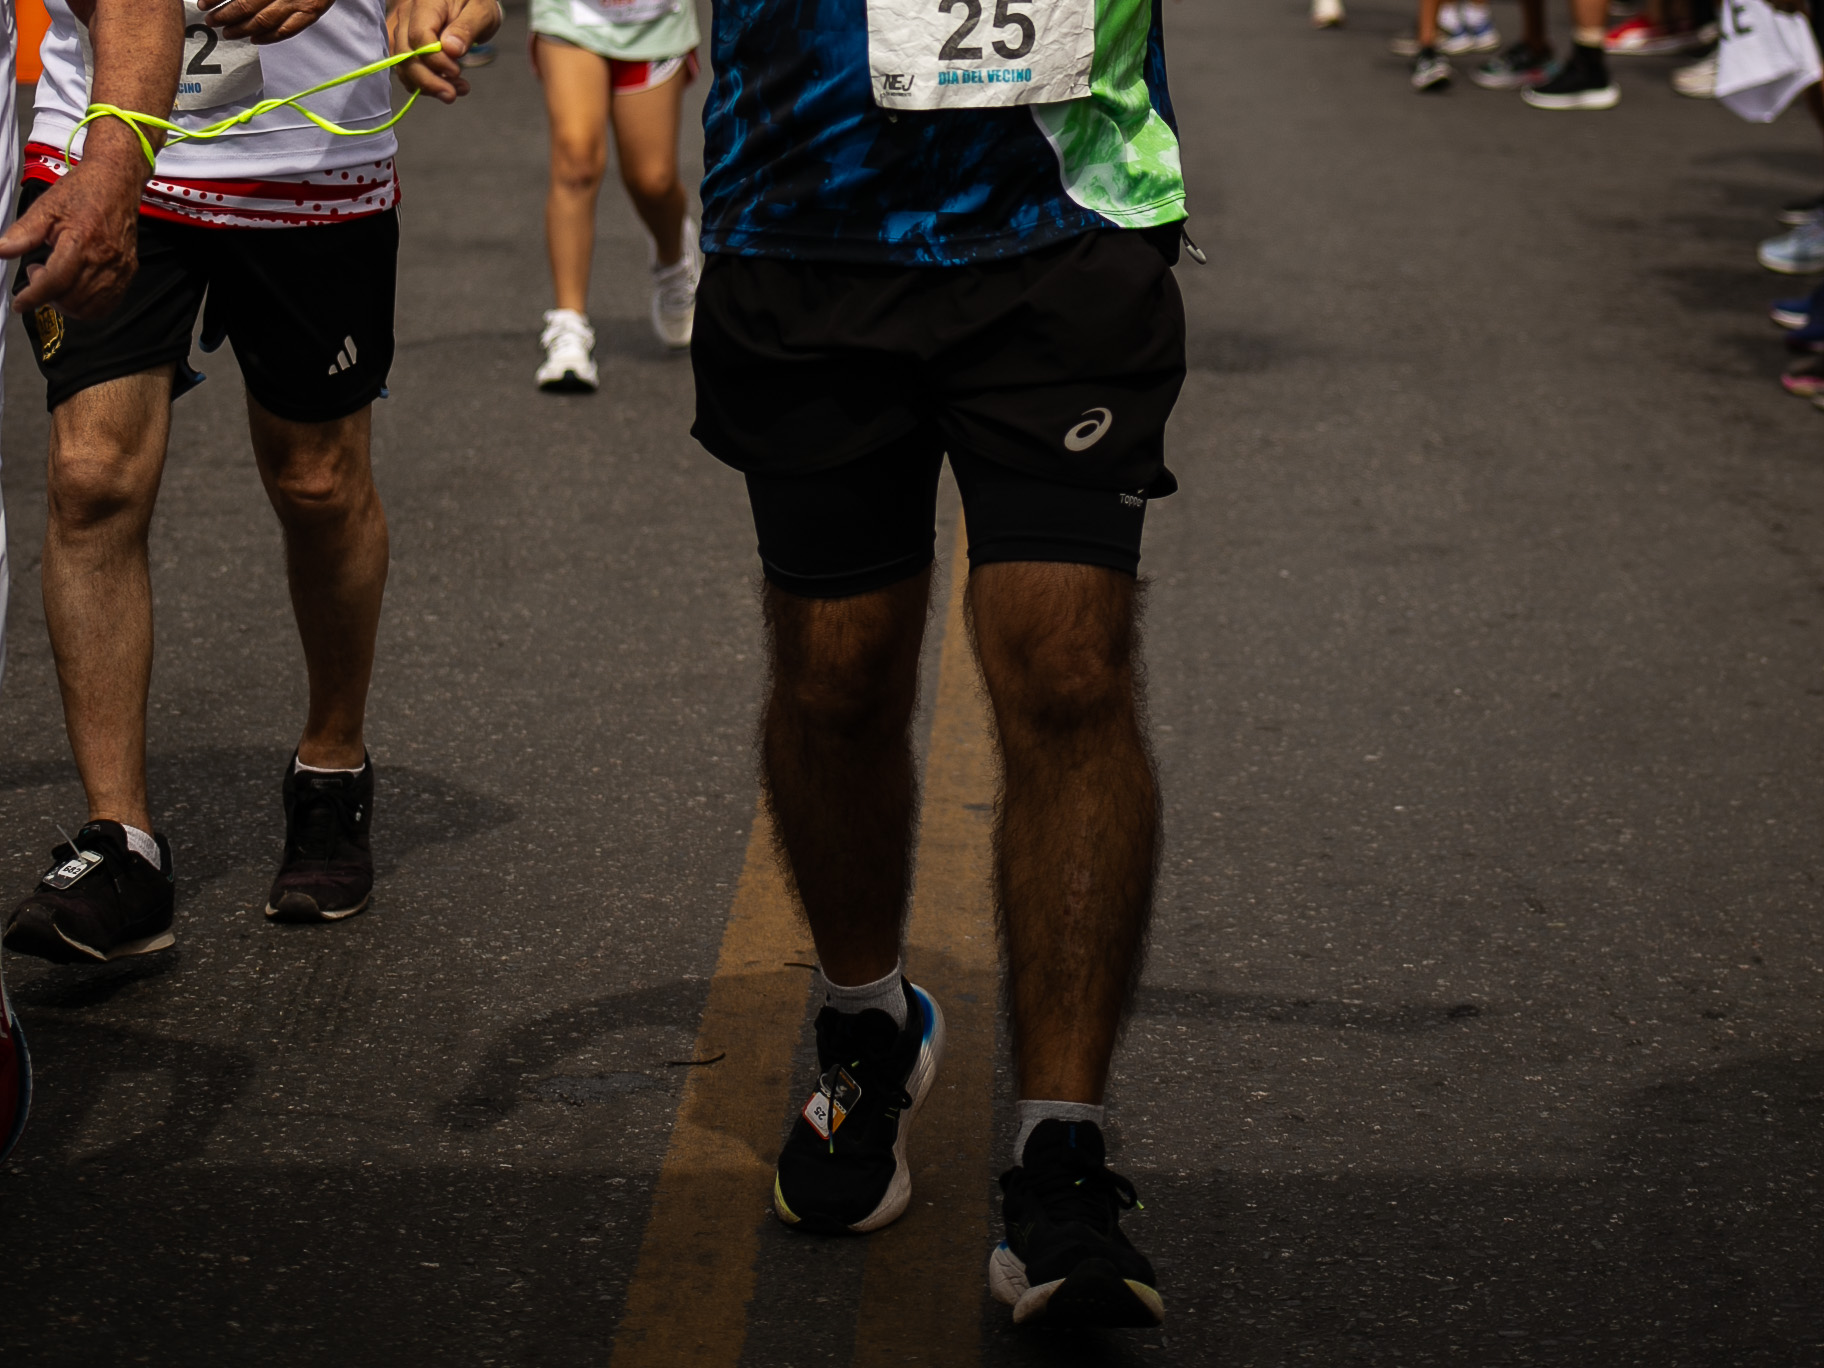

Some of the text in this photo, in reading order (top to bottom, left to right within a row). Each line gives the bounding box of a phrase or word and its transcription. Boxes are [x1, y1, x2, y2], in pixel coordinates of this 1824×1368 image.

[938, 68, 1032, 85] DIA DEL VECINO
[177, 82, 202, 94] CINO
[813, 1106, 827, 1121] 25
